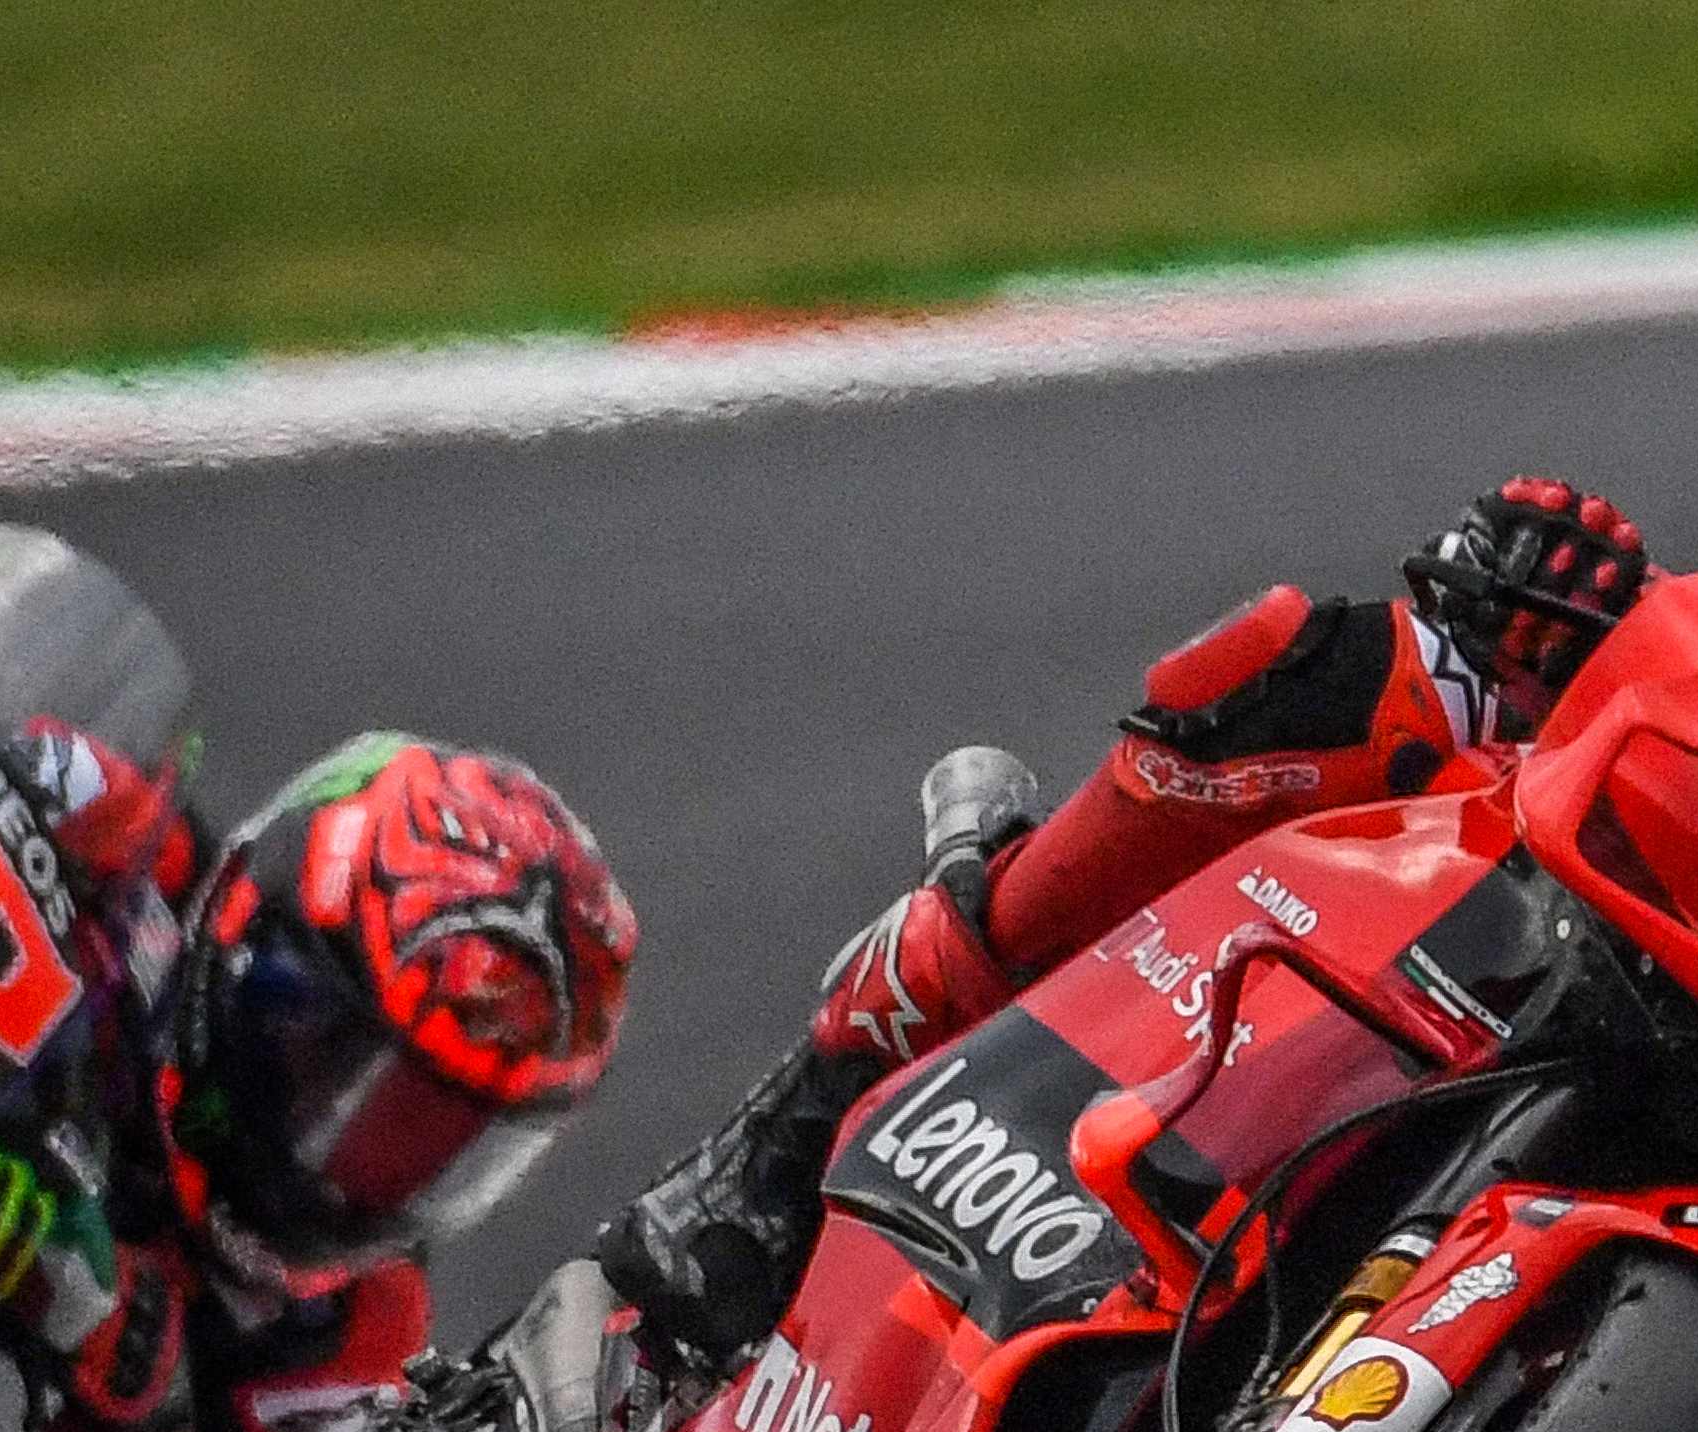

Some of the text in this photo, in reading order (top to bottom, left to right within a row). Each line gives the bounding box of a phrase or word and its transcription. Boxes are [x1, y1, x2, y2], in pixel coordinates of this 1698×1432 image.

[1131, 926, 1253, 1067] Audi Spt
[866, 1058, 1104, 1281] Lenovo
